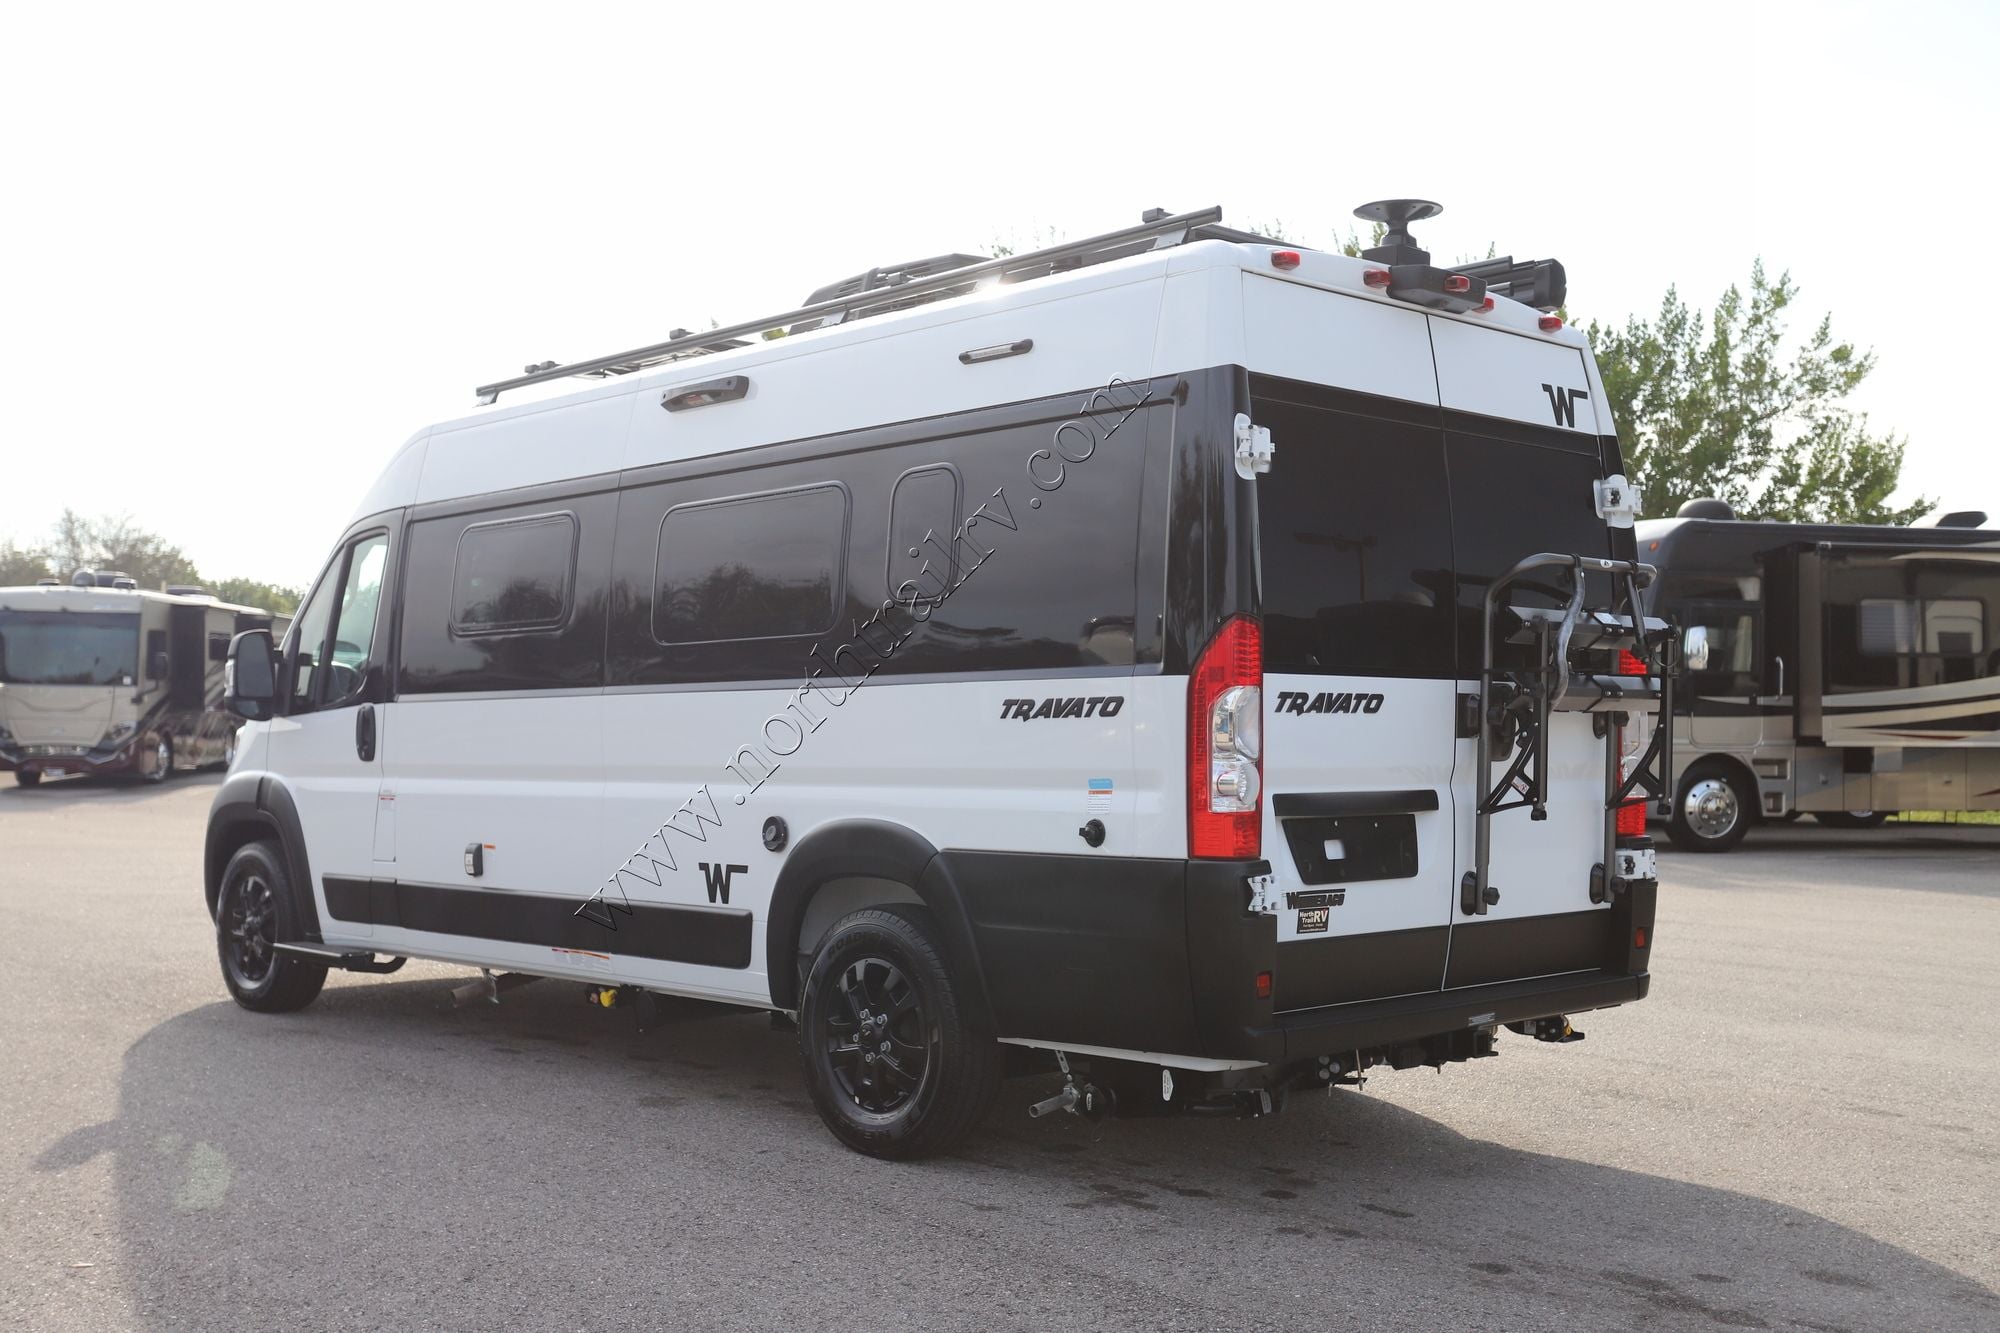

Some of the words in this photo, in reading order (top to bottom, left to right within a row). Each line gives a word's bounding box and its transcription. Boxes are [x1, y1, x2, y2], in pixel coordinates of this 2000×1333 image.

[1541, 383, 1588, 429] W
[1000, 696, 1125, 722] TRAVATO
[1275, 691, 1385, 717] TRAVATO
[698, 862, 749, 905] W
[1314, 910, 1328, 923] RV
